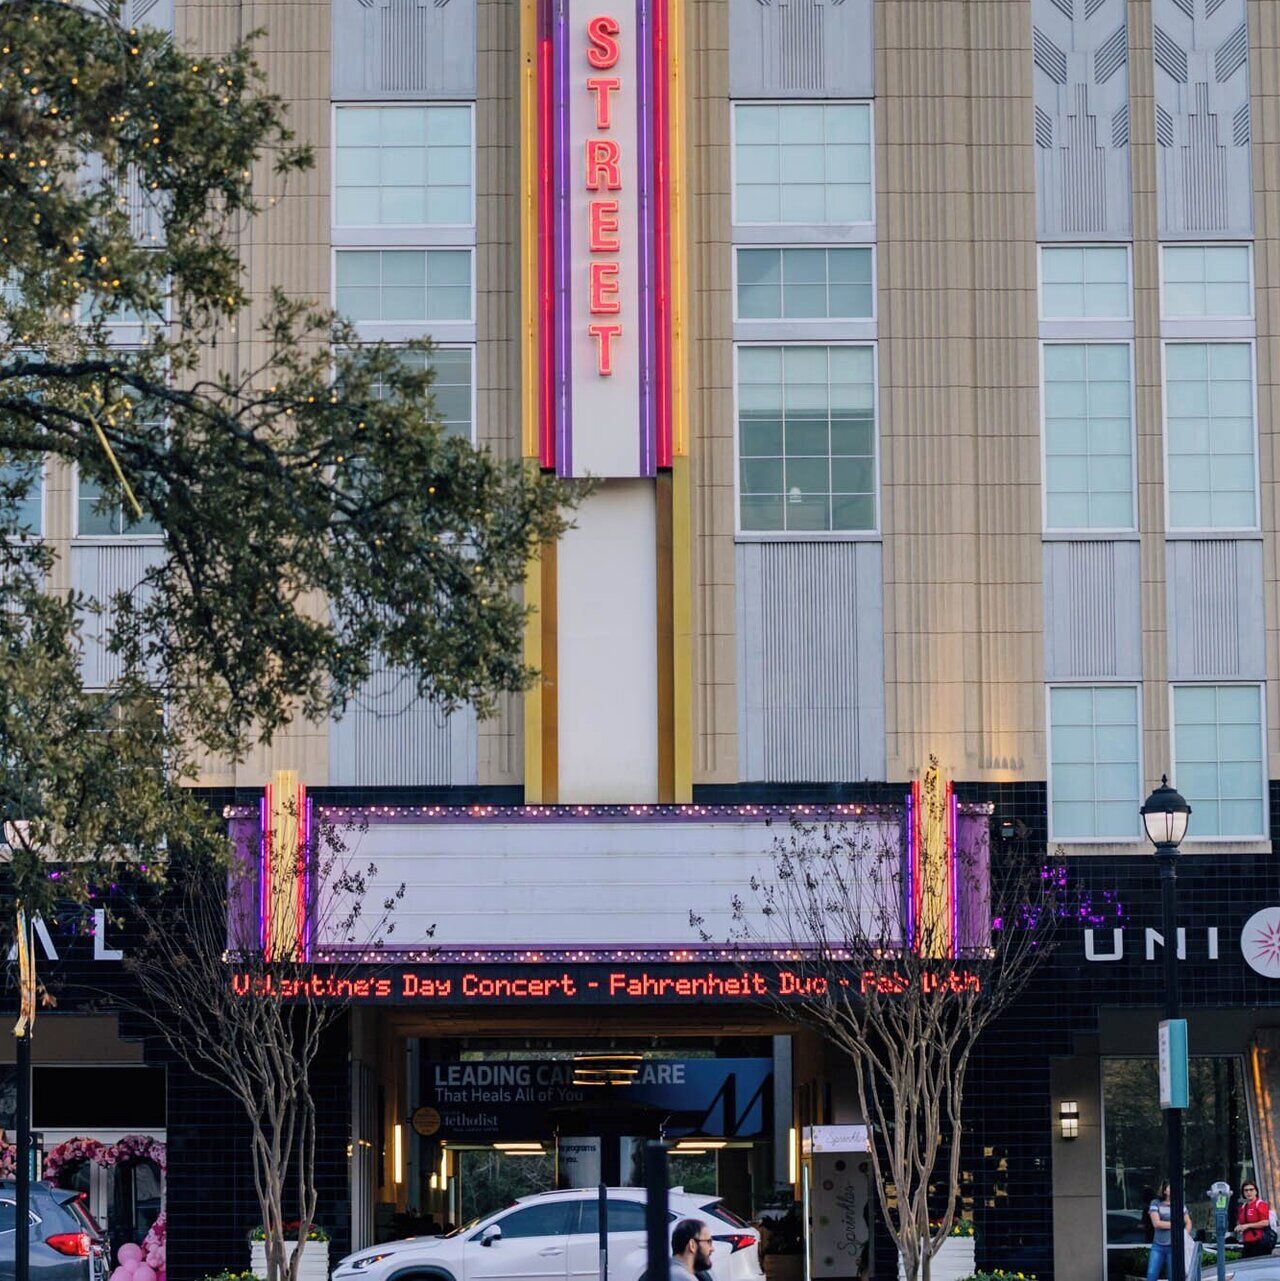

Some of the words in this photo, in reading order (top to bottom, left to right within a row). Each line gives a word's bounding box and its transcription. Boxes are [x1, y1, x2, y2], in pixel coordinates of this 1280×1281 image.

[585, 16, 622, 376] STREET
[1084, 927, 1218, 961] UNI
[402, 974, 451, 997] Day
[462, 974, 577, 997] Concert
[610, 973, 768, 997] Fahrenheit
[779, 972, 828, 995] Duo
[435, 1065, 530, 1086] LEADING
[436, 1087, 468, 1102] That
[472, 1087, 511, 1102] Heals
[516, 1087, 534, 1102] All
[538, 1087, 553, 1102] of
[557, 1088, 584, 1102] You
